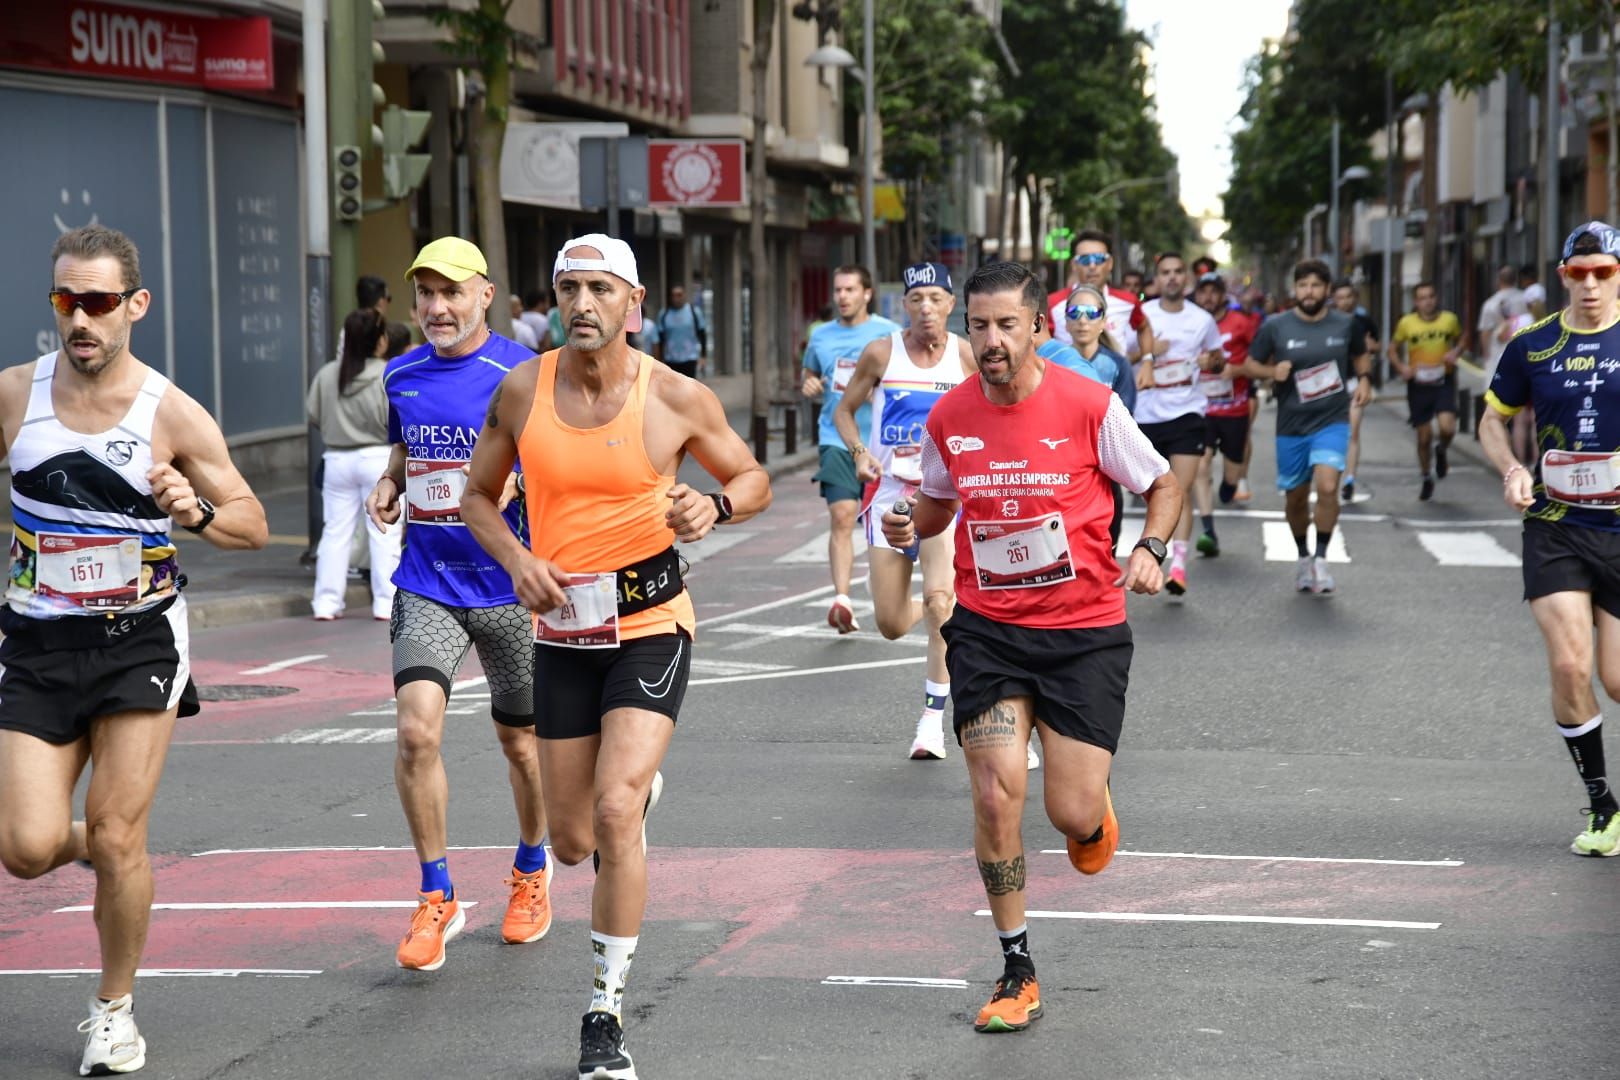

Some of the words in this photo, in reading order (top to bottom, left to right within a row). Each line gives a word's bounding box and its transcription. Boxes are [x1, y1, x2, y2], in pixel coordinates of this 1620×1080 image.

[71, 8, 165, 70] suma
[1566, 355, 1596, 371] VIDA
[408, 446, 429, 459] FOR
[434, 447, 472, 460] GOOD
[989, 460, 1028, 470] Canarias7
[958, 474, 991, 488] CARRERA
[993, 474, 1005, 486] DE
[1005, 473, 1020, 485] LAS
[1021, 473, 1070, 485] EMPRESAS
[426, 484, 451, 501] 1728
[978, 489, 1002, 498] PALMAS
[1002, 489, 1009, 497] DE
[1009, 488, 1026, 497] GRAN
[1027, 488, 1055, 497] CANARIA
[1007, 546, 1029, 564] 267
[70, 562, 103, 582] 1517
